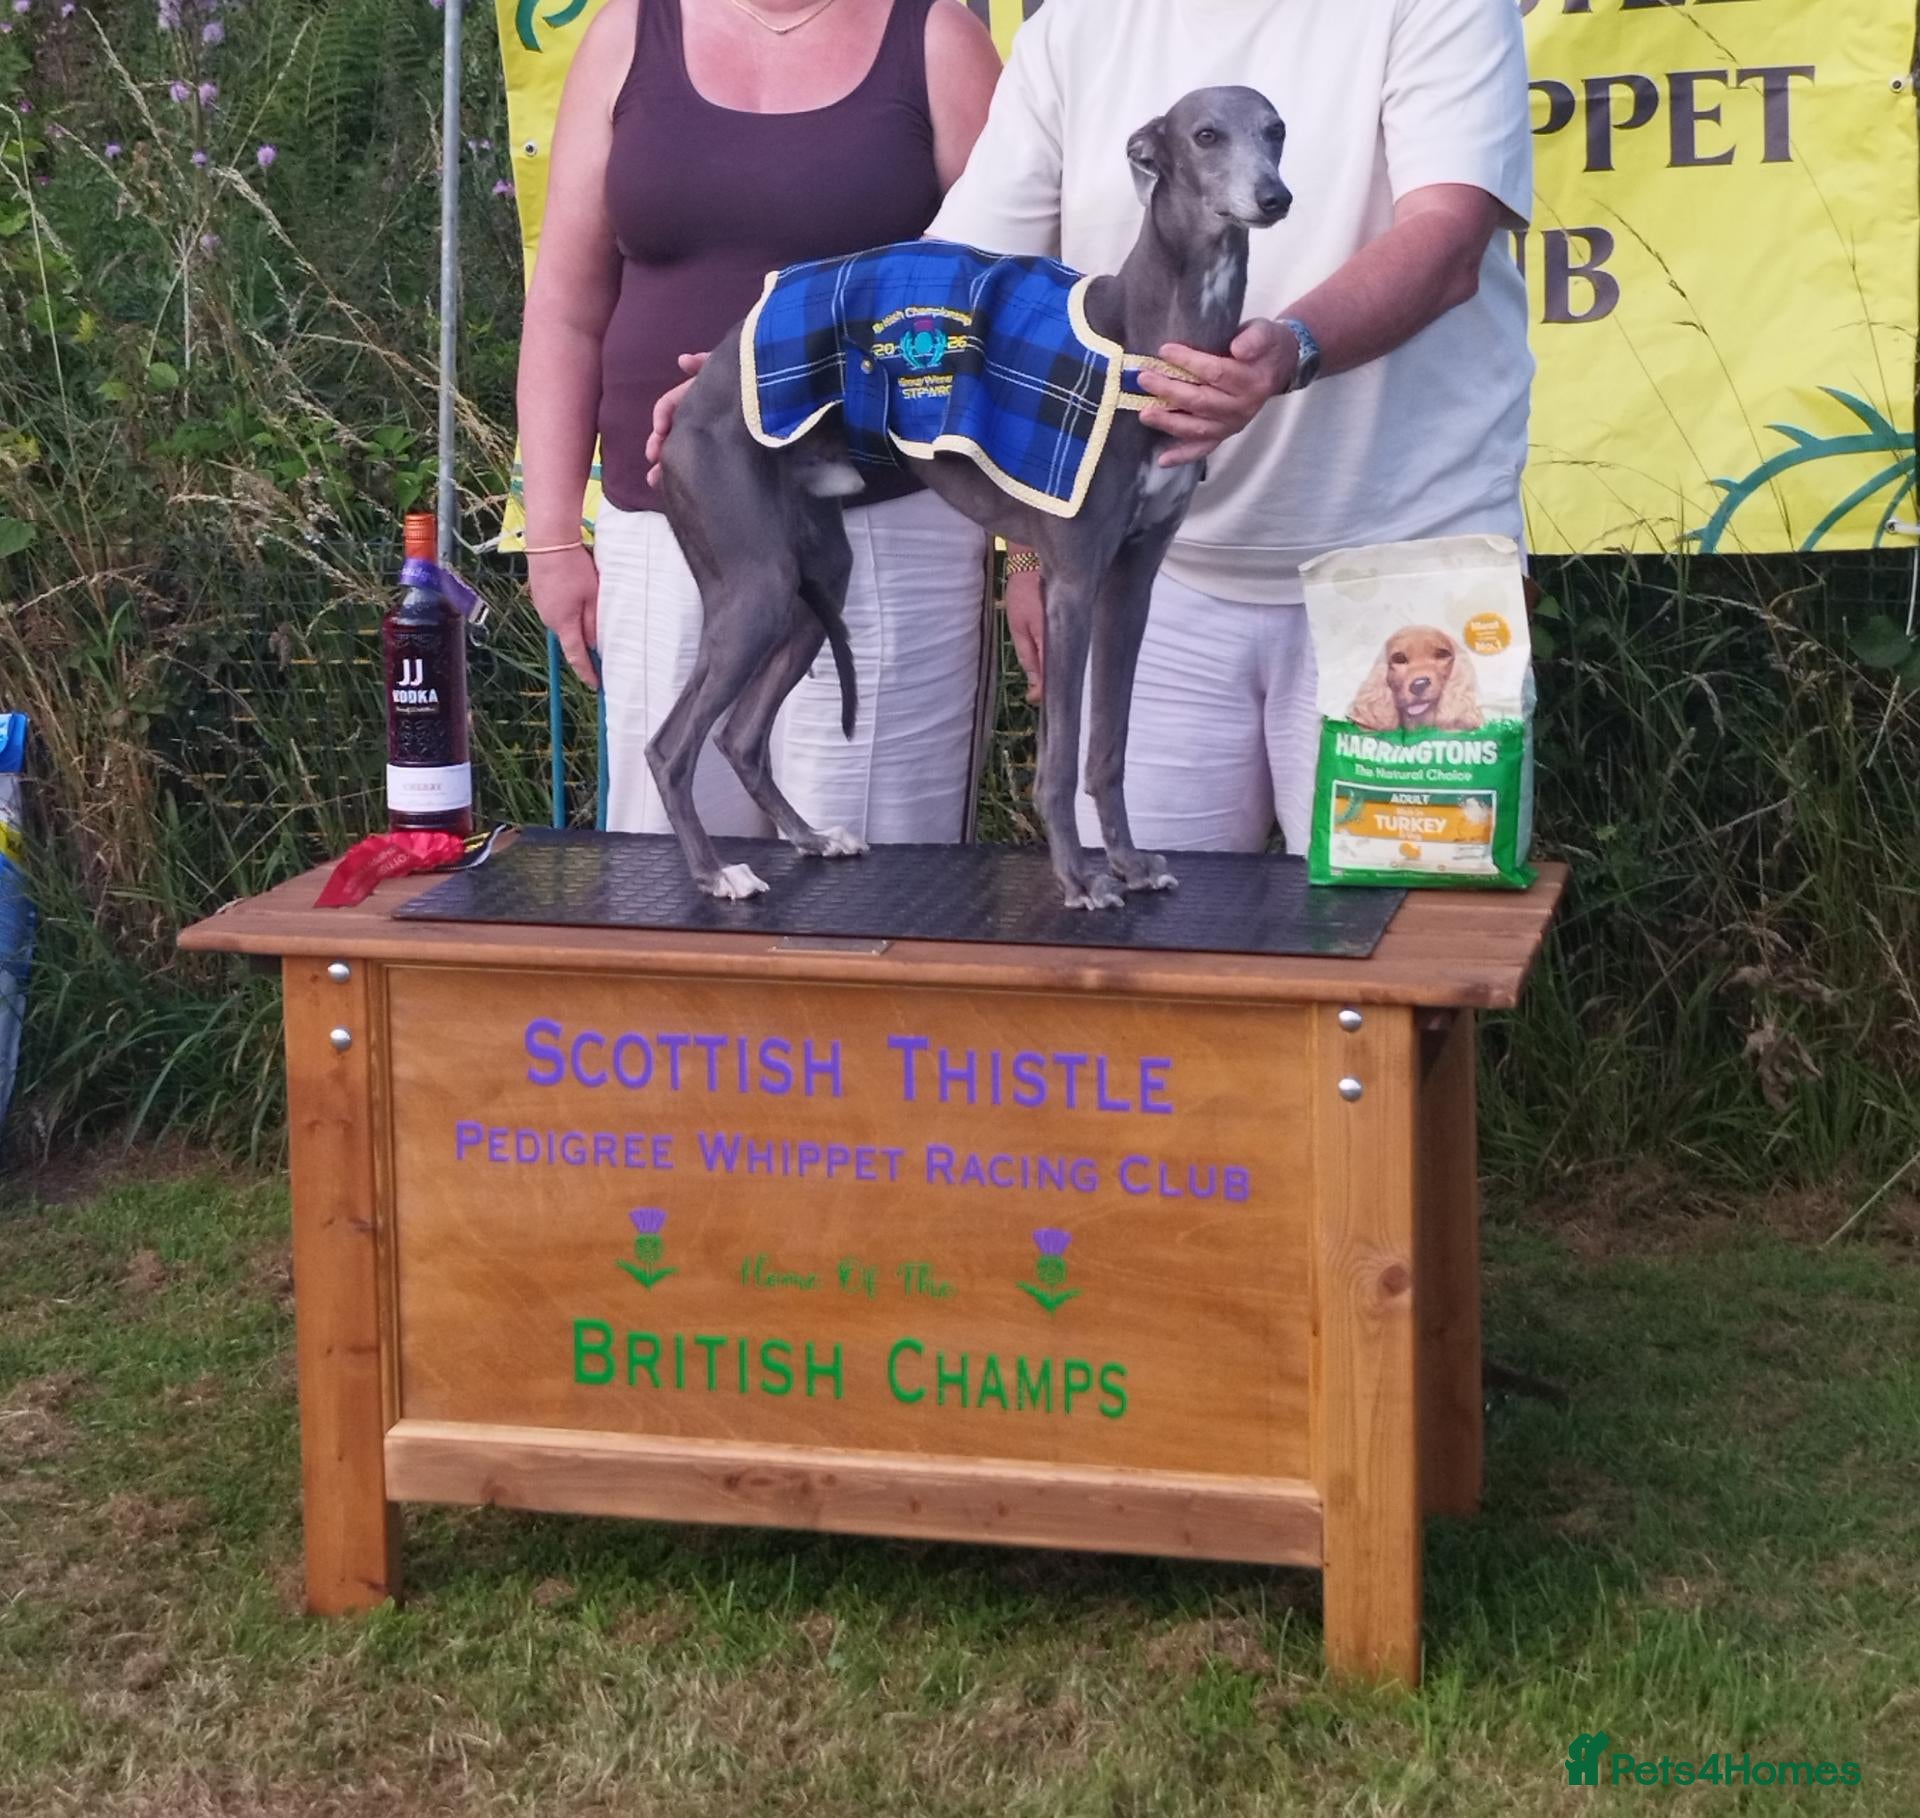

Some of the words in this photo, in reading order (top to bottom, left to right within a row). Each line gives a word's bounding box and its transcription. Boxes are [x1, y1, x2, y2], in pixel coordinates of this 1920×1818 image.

[872, 343, 895, 357] 20
[396, 658, 423, 686] JJ
[392, 688, 439, 704] VODKA
[1336, 732, 1498, 764] HARRINGTONS
[1355, 764, 1373, 776] The
[1375, 767, 1424, 781] Natural
[1426, 768, 1473, 781] Choice
[1390, 793, 1431, 805] ADULT
[1373, 814, 1447, 834] TURKEY
[524, 1016, 842, 1097] SCOTTISH
[887, 1034, 1174, 1114] THISTLE
[455, 1120, 674, 1169] PEDIGREE
[697, 1131, 904, 1180] WHIPPET
[926, 1143, 1098, 1193] RACING
[1118, 1154, 1250, 1202] CLUB
[741, 1253, 821, 1291] Home
[836, 1256, 876, 1301] Of
[894, 1261, 958, 1297] The
[573, 1317, 843, 1400] BRITISH
[887, 1336, 1128, 1419] CHAMPS
